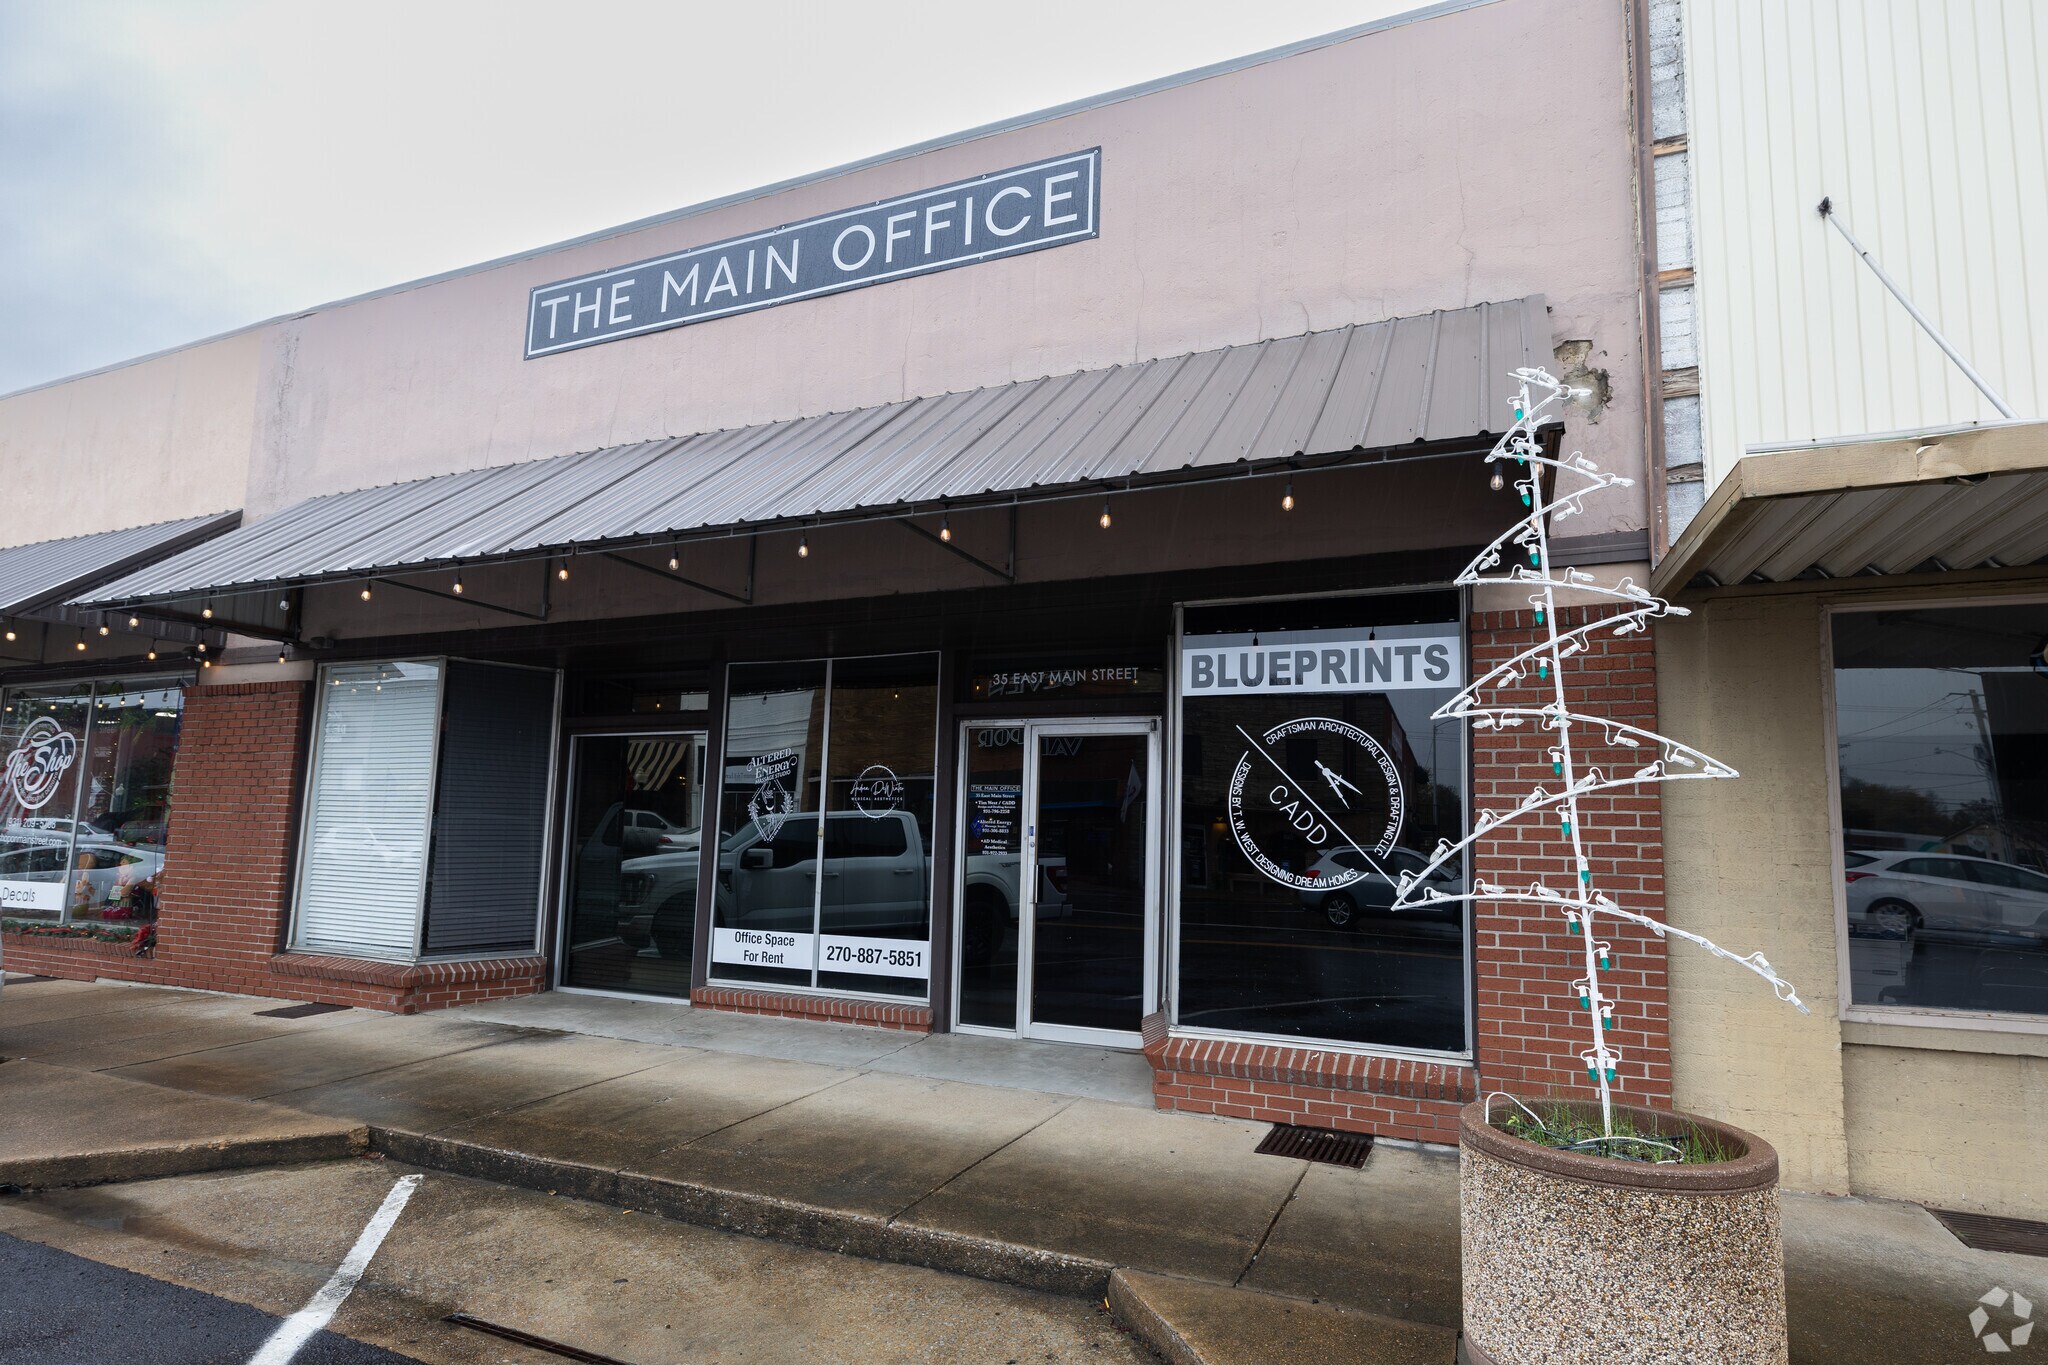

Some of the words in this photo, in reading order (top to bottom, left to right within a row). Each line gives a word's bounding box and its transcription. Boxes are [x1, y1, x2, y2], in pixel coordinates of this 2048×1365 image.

[541, 279, 635, 339] THE
[660, 239, 799, 313] MAIN
[832, 171, 1079, 272] OFFICE
[993, 674, 1008, 685] 35
[1013, 672, 1044, 684] EAST
[1050, 670, 1086, 682] MAIN
[1091, 668, 1139, 681] STREET
[1191, 644, 1450, 688] BLUEPRINTS
[1266, 721, 1316, 745] CRAFTSMAN
[1318, 721, 1380, 759] ARCHITECTURAL
[5, 747, 30, 784] The
[24, 746, 72, 792] Shop
[755, 756, 798, 779] ENERGY
[774, 769, 792, 780] STUDIO
[1232, 762, 1252, 796] DESIGNS
[1377, 756, 1398, 786] DESIGN
[1232, 797, 1241, 808] BY
[1269, 785, 1327, 844] CADD
[1383, 797, 1400, 840] DRAFTING
[1240, 832, 1260, 855] WEST
[1374, 839, 1390, 856] LLC
[1255, 853, 1294, 883] DESIGNING
[1328, 868, 1358, 886] HOMES
[1295, 875, 1327, 888] DREAM
[3, 887, 36, 902] Decals
[734, 931, 762, 945] Office
[763, 932, 795, 947] Space
[743, 950, 758, 963] For
[761, 951, 784, 964] Rent
[826, 945, 922, 967] 270-887-5851
